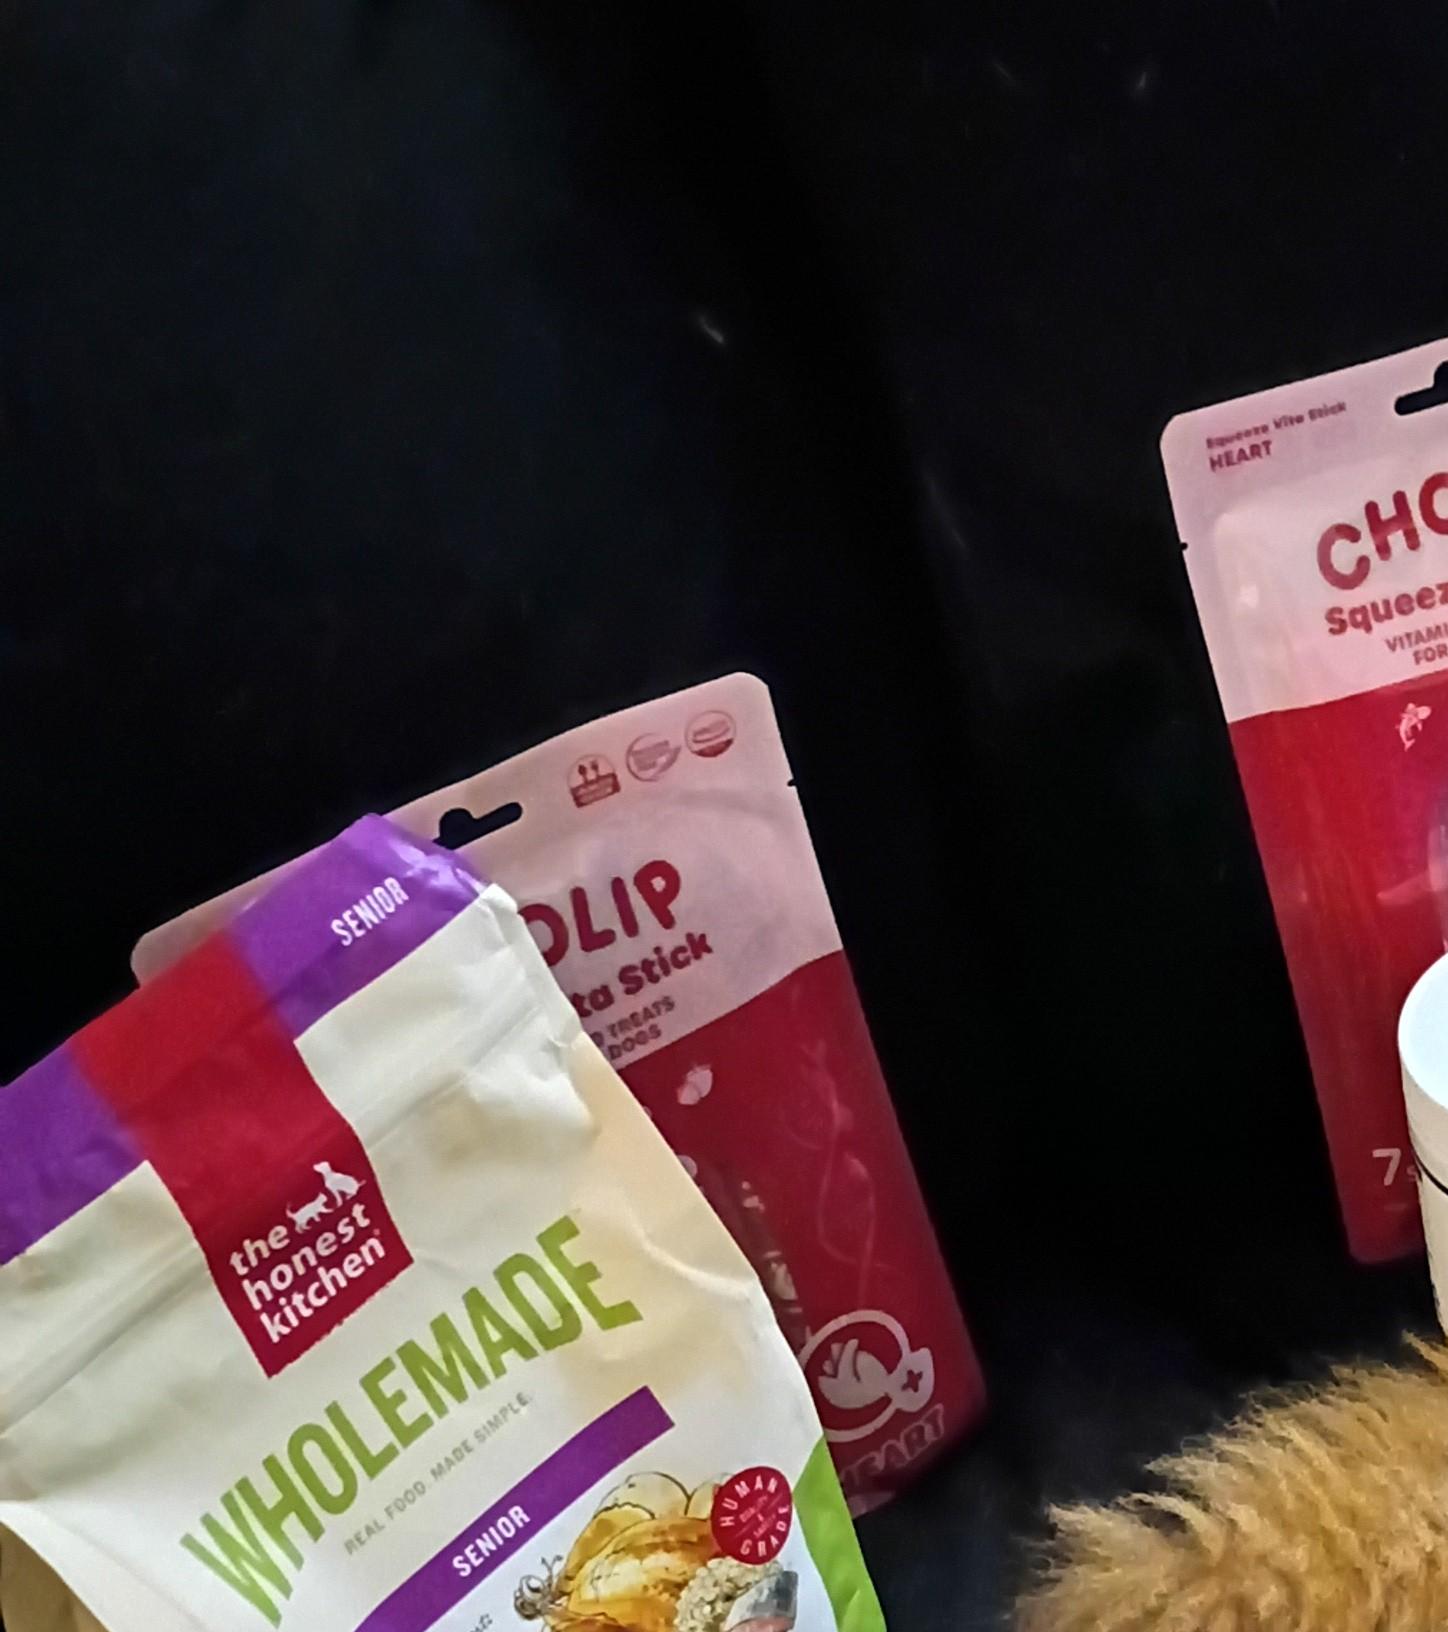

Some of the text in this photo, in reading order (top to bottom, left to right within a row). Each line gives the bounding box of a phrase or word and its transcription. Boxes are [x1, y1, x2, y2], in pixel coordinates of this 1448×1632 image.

[1209, 440, 1272, 472] HEART
[1413, 643, 1448, 666] FOR
[331, 877, 409, 946] SENIOR
[618, 932, 713, 995] Stick
[607, 996, 675, 1037] TREATS
[608, 1024, 662, 1060] DOGS
[230, 1225, 290, 1275] the
[241, 1203, 370, 1310] honest
[260, 1237, 386, 1343] kitchen
[180, 1215, 643, 1629] WHOLEMADE
[343, 1519, 385, 1555] REAL
[430, 1439, 474, 1481] MADE
[720, 1475, 778, 1527] HUMAN
[453, 1505, 530, 1577] SENIOR
